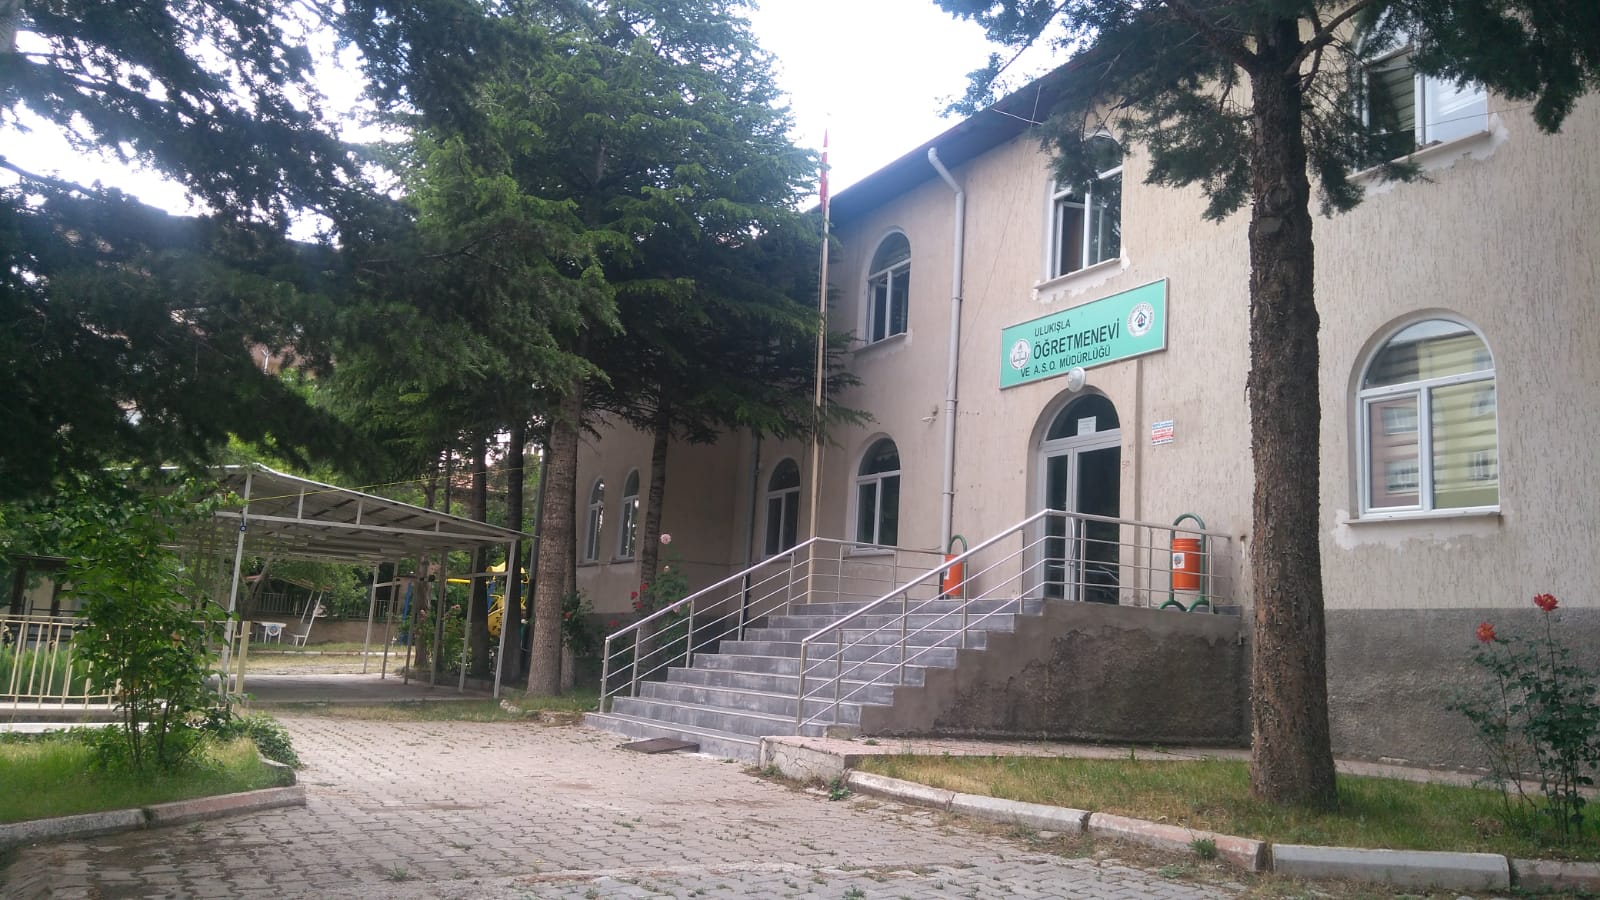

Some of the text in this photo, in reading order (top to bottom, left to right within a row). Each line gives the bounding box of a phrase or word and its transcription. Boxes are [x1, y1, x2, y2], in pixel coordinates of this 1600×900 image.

[1033, 318, 1119, 360] ÖĞRETMENEVİ
[1034, 319, 1071, 337] ULUKIŞLA
[1021, 367, 1030, 377] VE
[1060, 344, 1111, 368] MÜDÜRLÜĞÜ
